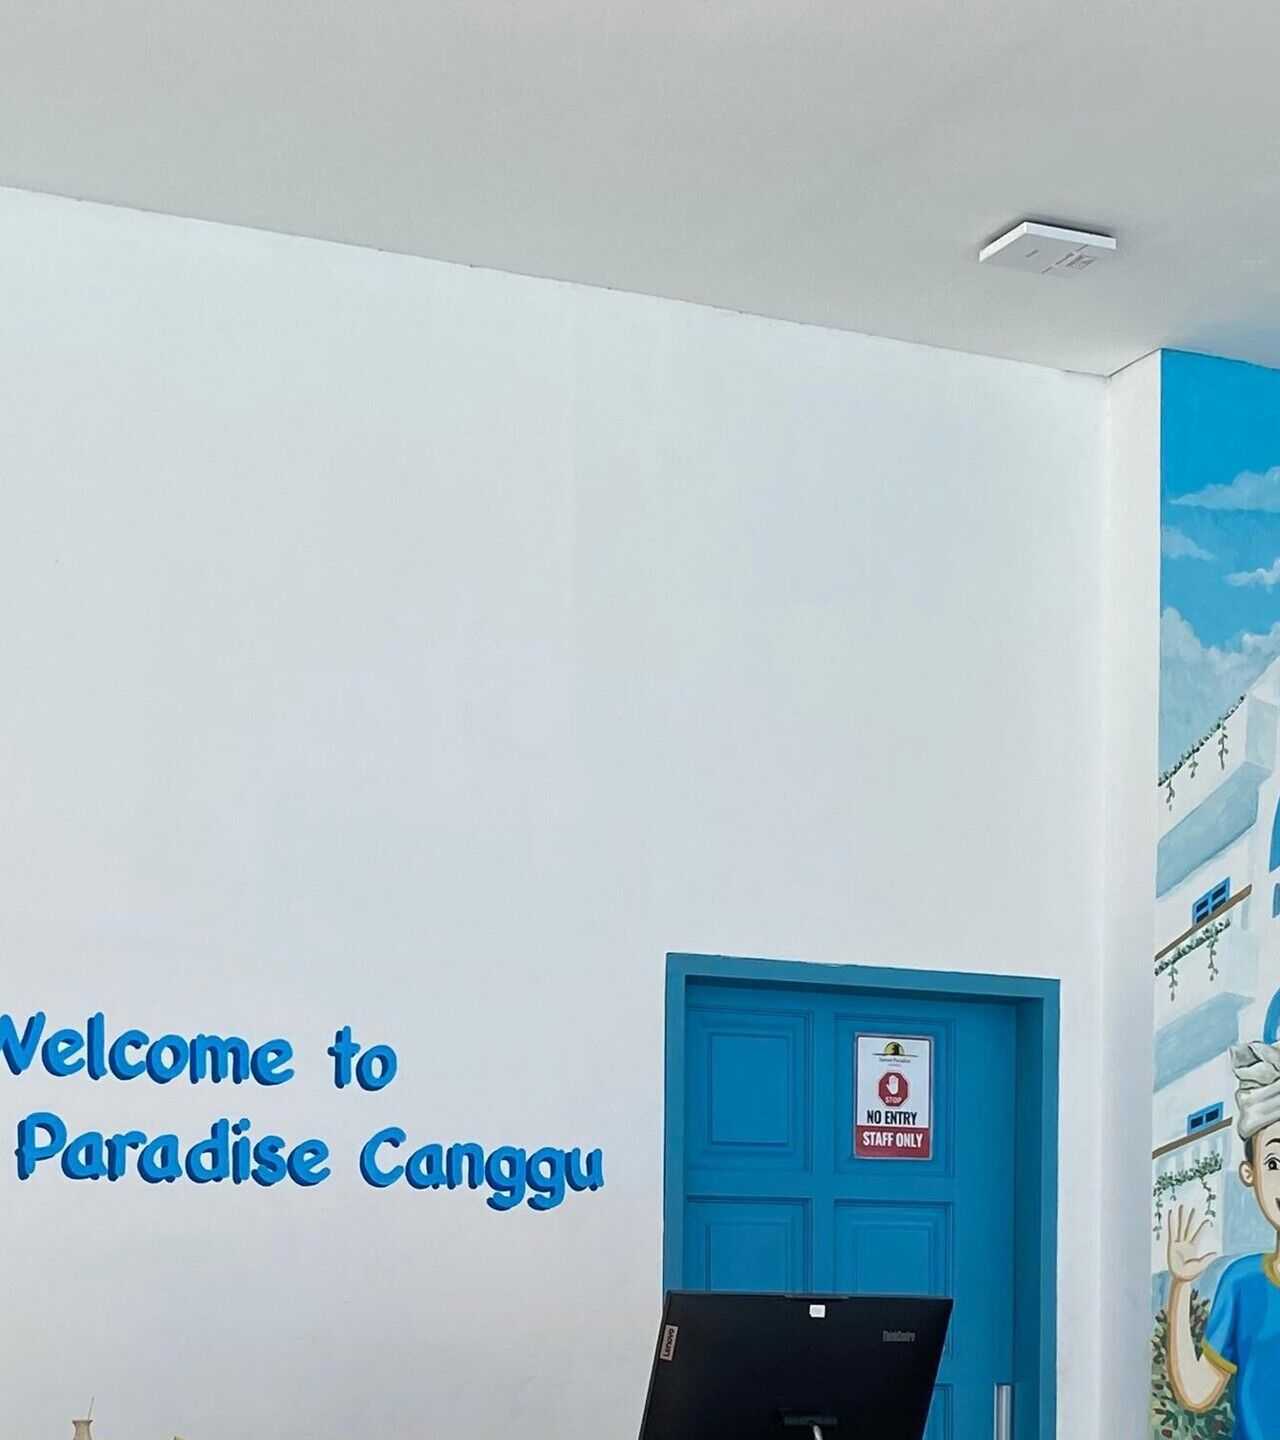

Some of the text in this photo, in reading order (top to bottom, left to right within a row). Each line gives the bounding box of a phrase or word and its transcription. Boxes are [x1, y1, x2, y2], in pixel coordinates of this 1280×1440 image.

[327, 1024, 399, 1091] to
[885, 1096, 902, 1104] STOP
[867, 1109, 918, 1126] NO ENTRY
[862, 1131, 924, 1148] STAFF ONLY
[15, 1110, 333, 1187] Paradise
[358, 1124, 605, 1211] Canggu
